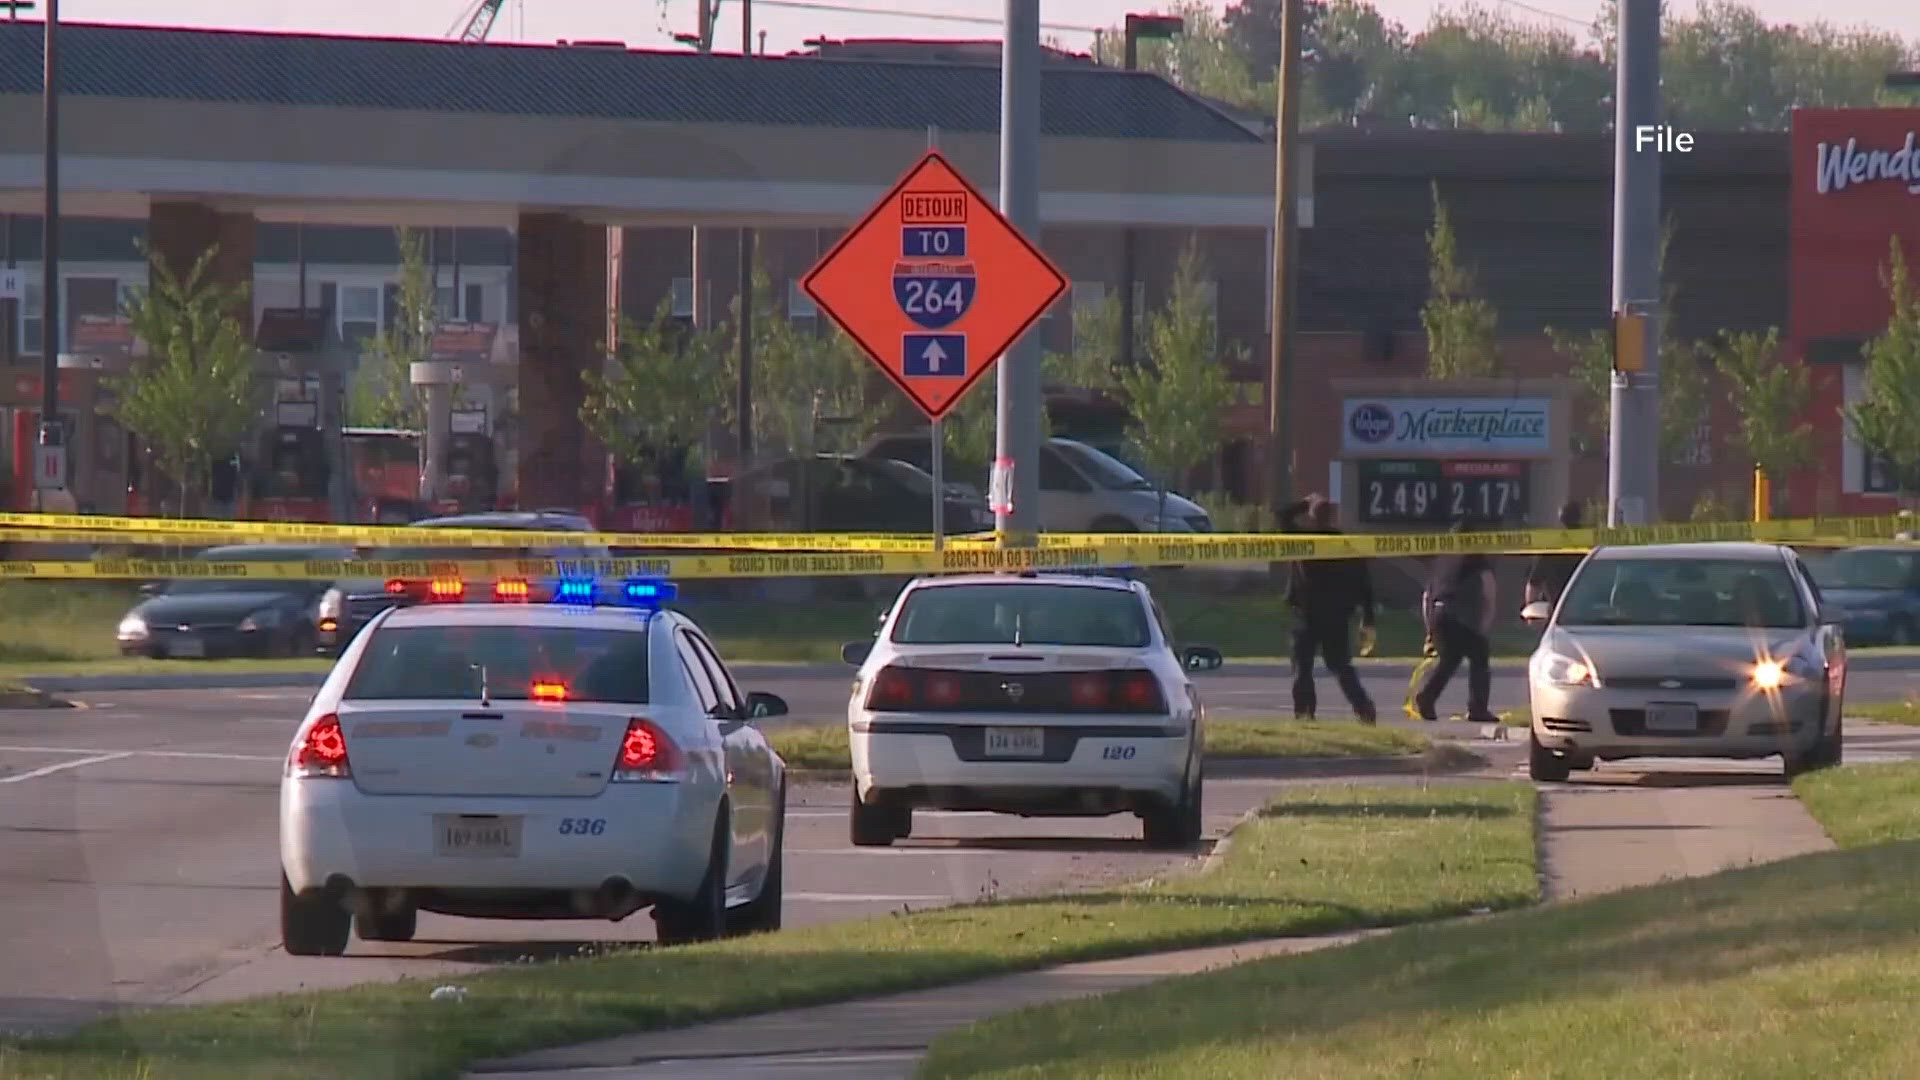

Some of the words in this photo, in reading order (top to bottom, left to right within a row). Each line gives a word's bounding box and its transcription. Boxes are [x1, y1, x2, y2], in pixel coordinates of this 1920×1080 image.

[905, 198, 963, 217] DETOUR
[919, 231, 949, 253] TO
[905, 281, 963, 314] 264
[1397, 407, 1544, 441] Marketplace
[1103, 746, 1136, 760] 120
[559, 818, 607, 835] 536
